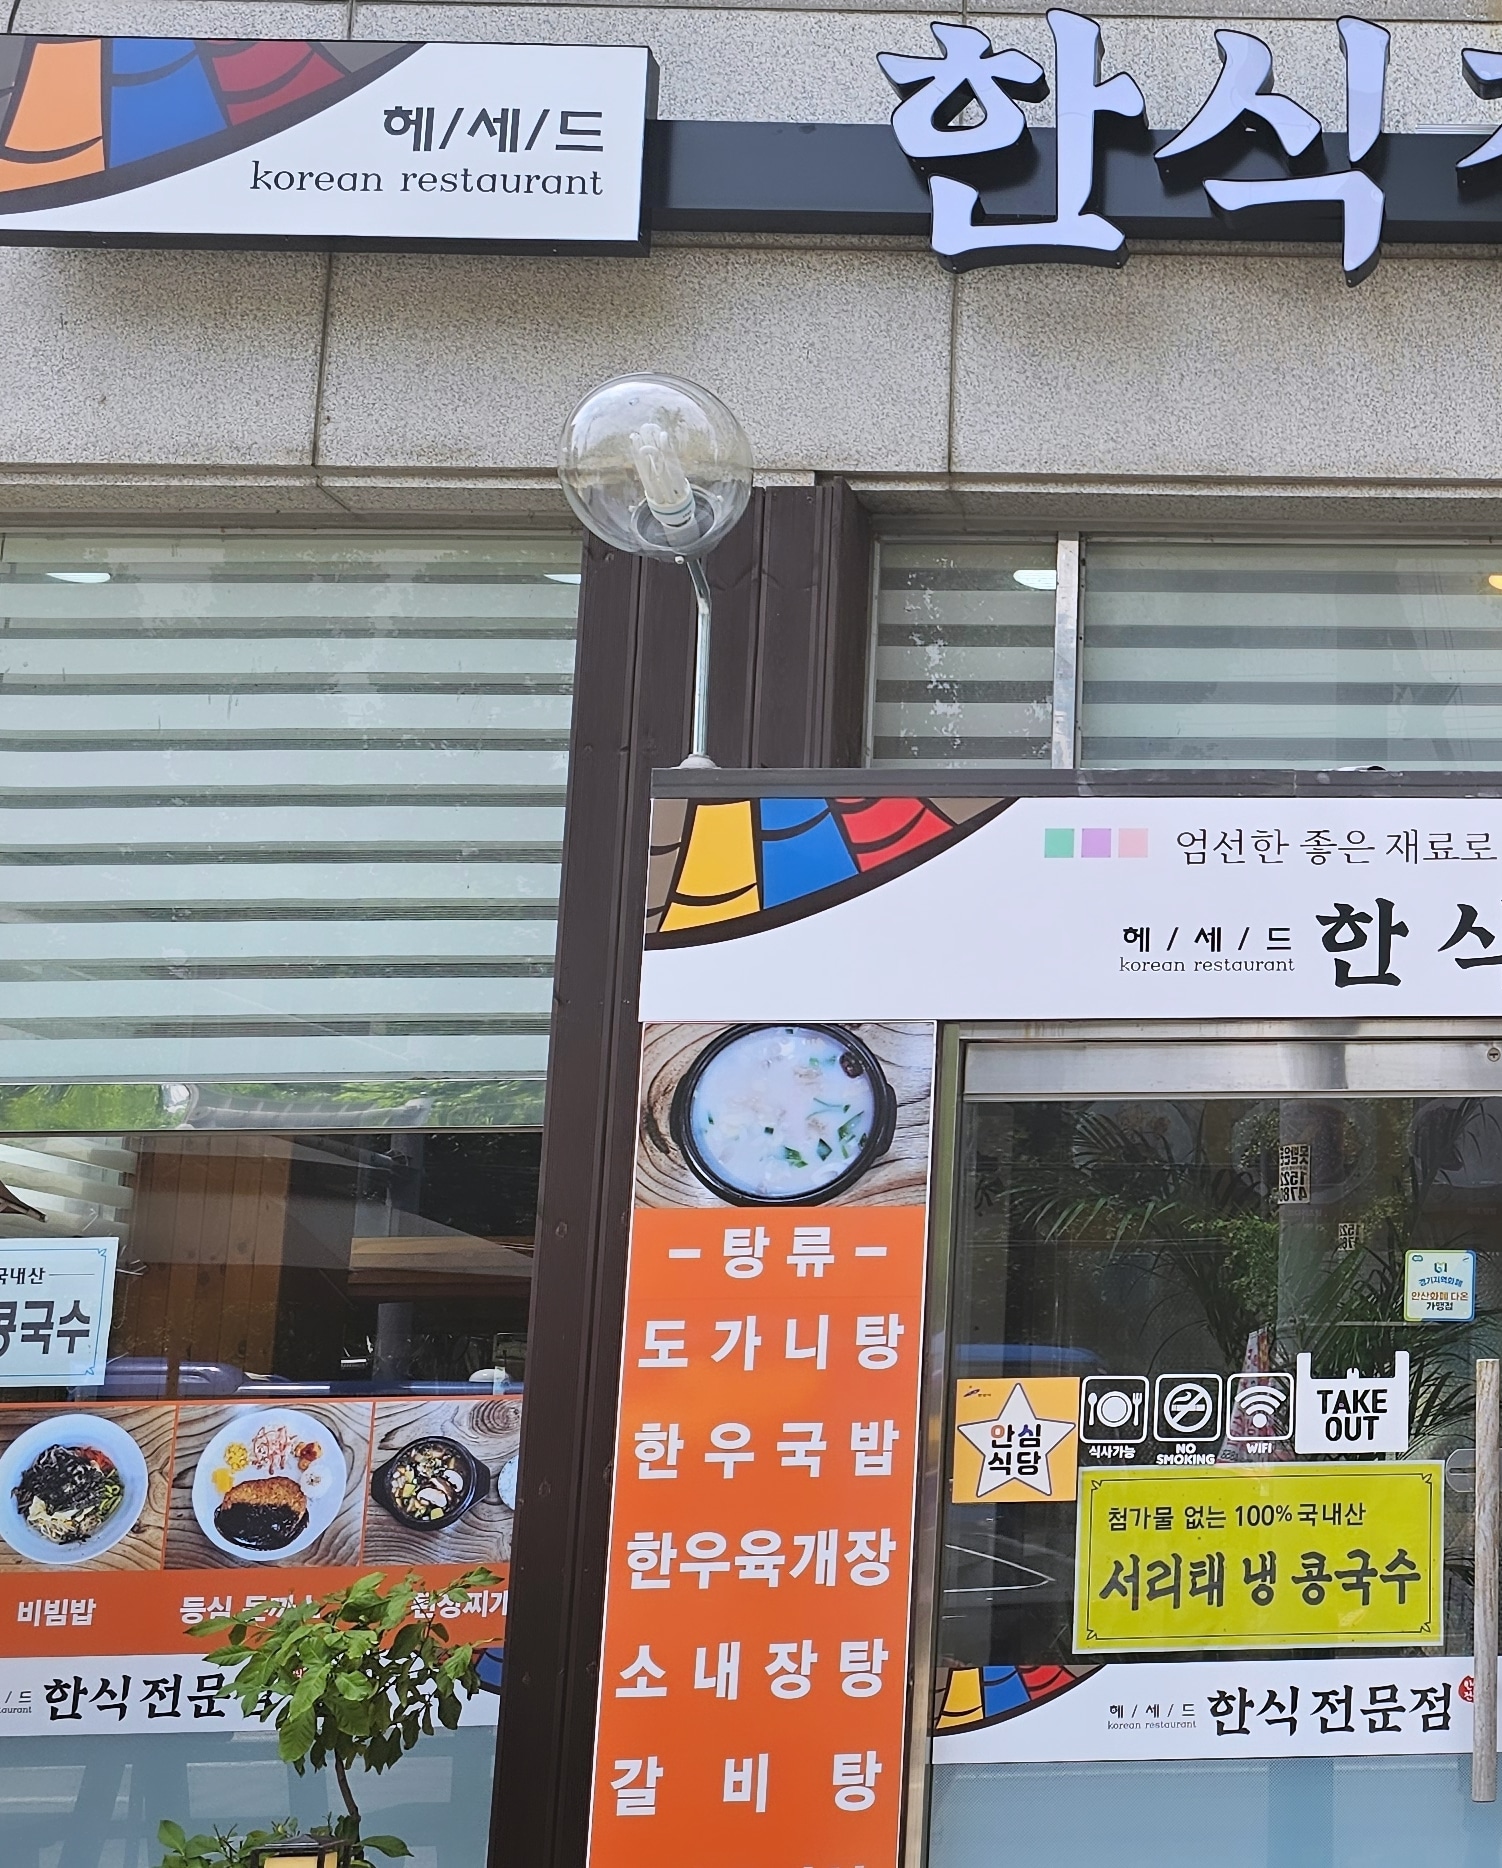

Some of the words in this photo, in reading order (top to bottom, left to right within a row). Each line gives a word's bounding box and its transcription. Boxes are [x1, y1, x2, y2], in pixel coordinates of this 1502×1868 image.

[384, 106, 603, 152] 헤/세/드
[250, 161, 383, 193] korean
[400, 168, 603, 196] restaurant
[1176, 828, 1290, 866] 엄선한
[1300, 828, 1376, 866] 좋은
[1386, 828, 1498, 866] 재료로
[1119, 956, 1186, 972] korean
[1194, 957, 1296, 972] restaurant
[723, 1226, 835, 1279] 탕류
[1411, 1291, 1448, 1301] 안산화폐
[1426, 1301, 1454, 1312] 가맹점
[637, 1313, 905, 1371] 도가니탕
[1317, 1389, 1388, 1415] TAKE
[990, 1423, 1042, 1449] 안심
[1325, 1416, 1380, 1441] OUT
[634, 1419, 900, 1480] 한우국밥
[1088, 1444, 1136, 1459] 식사가능
[1155, 1454, 1216, 1465] SMOKING
[1175, 1443, 1197, 1454] NO
[987, 1452, 1042, 1477] 식당
[1108, 1506, 1174, 1531] 첨가물
[1184, 1505, 1227, 1529] 없는
[626, 1528, 897, 1590] 한우육개장
[1099, 1551, 1226, 1611] 서리태
[1242, 1551, 1277, 1606] 냉
[1291, 1549, 1421, 1606] 콩국수
[17, 1598, 96, 1627] 비빔밥
[179, 1595, 232, 1625] 등심
[615, 1638, 889, 1700] 소내장탕
[1107, 1720, 1141, 1729] korean
[1145, 1720, 1197, 1729] restaurant
[610, 1750, 882, 1816] 갈비탕
